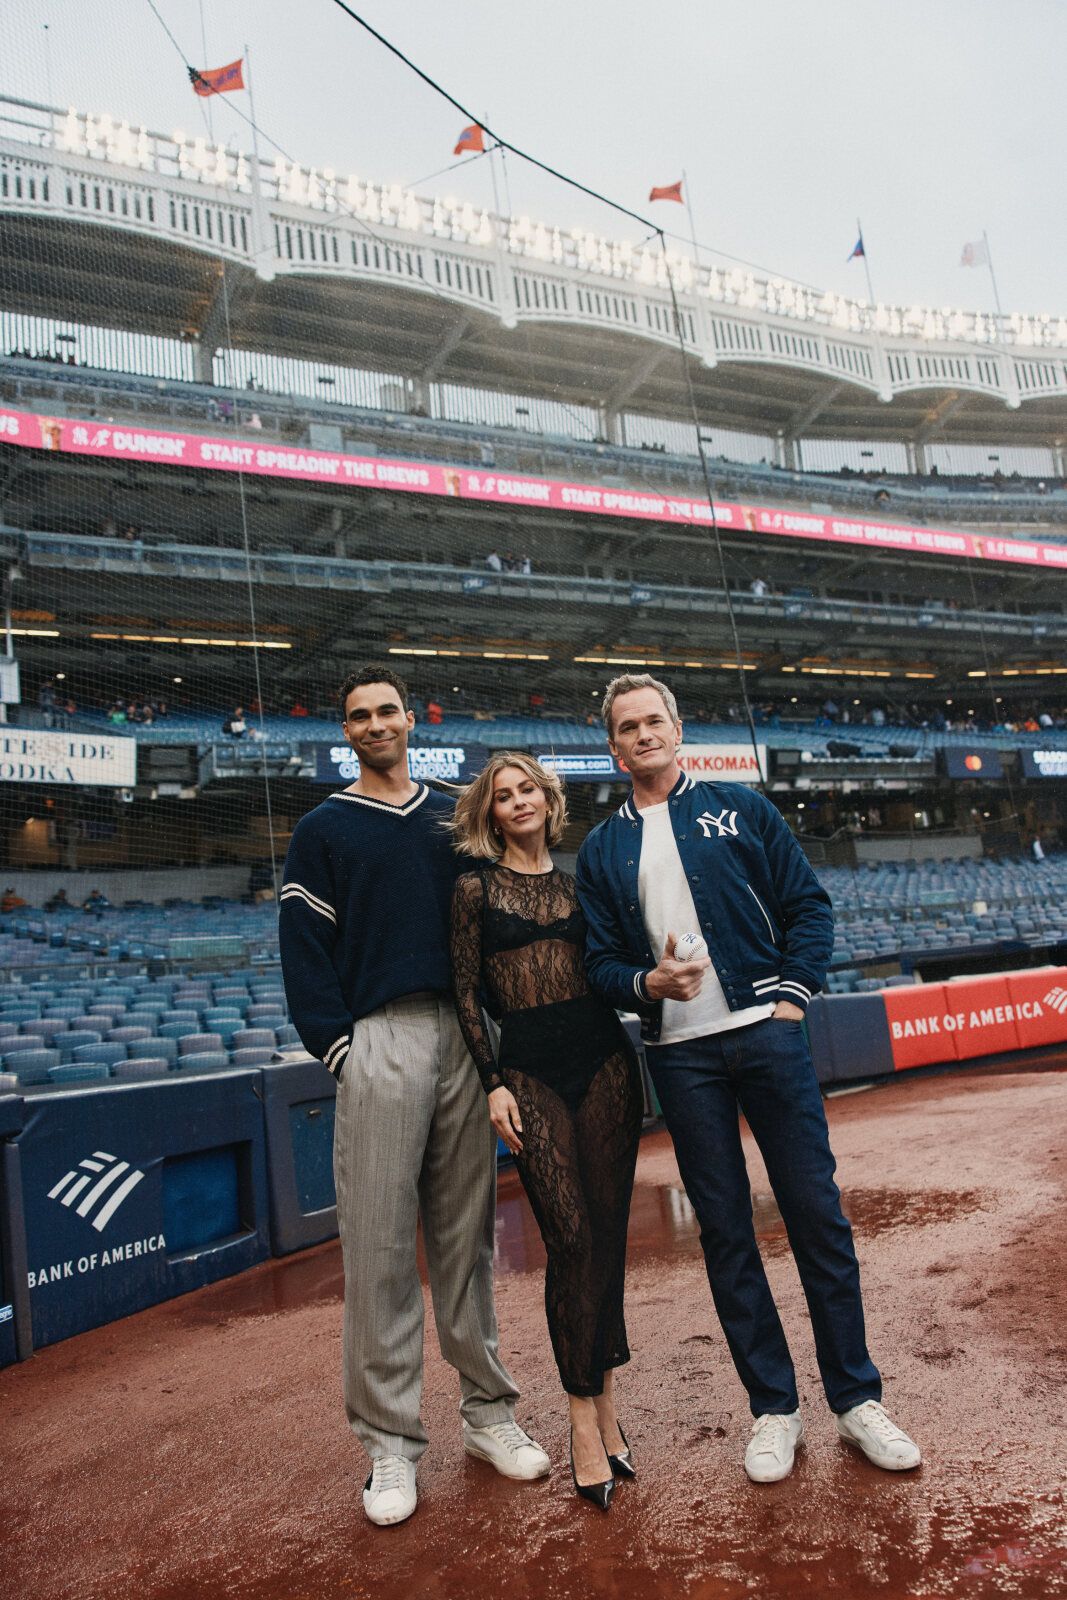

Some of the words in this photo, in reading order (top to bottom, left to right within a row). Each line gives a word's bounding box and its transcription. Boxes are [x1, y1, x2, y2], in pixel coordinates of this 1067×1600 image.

[112, 432, 186, 457] DUNKIN'
[200, 443, 253, 465] START
[256, 450, 340, 475] SPREADIN'
[343, 460, 375, 479] THE
[376, 465, 430, 487] BREWS
[406, 747, 465, 764] ICKETS
[676, 755, 759, 772] KIKKOMAN
[0, 763, 75, 782] ODKA
[891, 1015, 941, 1040] BANK
[943, 1013, 965, 1032] OF
[969, 1001, 1044, 1029] AMERICA
[27, 1261, 74, 1288] BANK
[77, 1253, 98, 1273] OF
[100, 1233, 167, 1267] AMERICA
